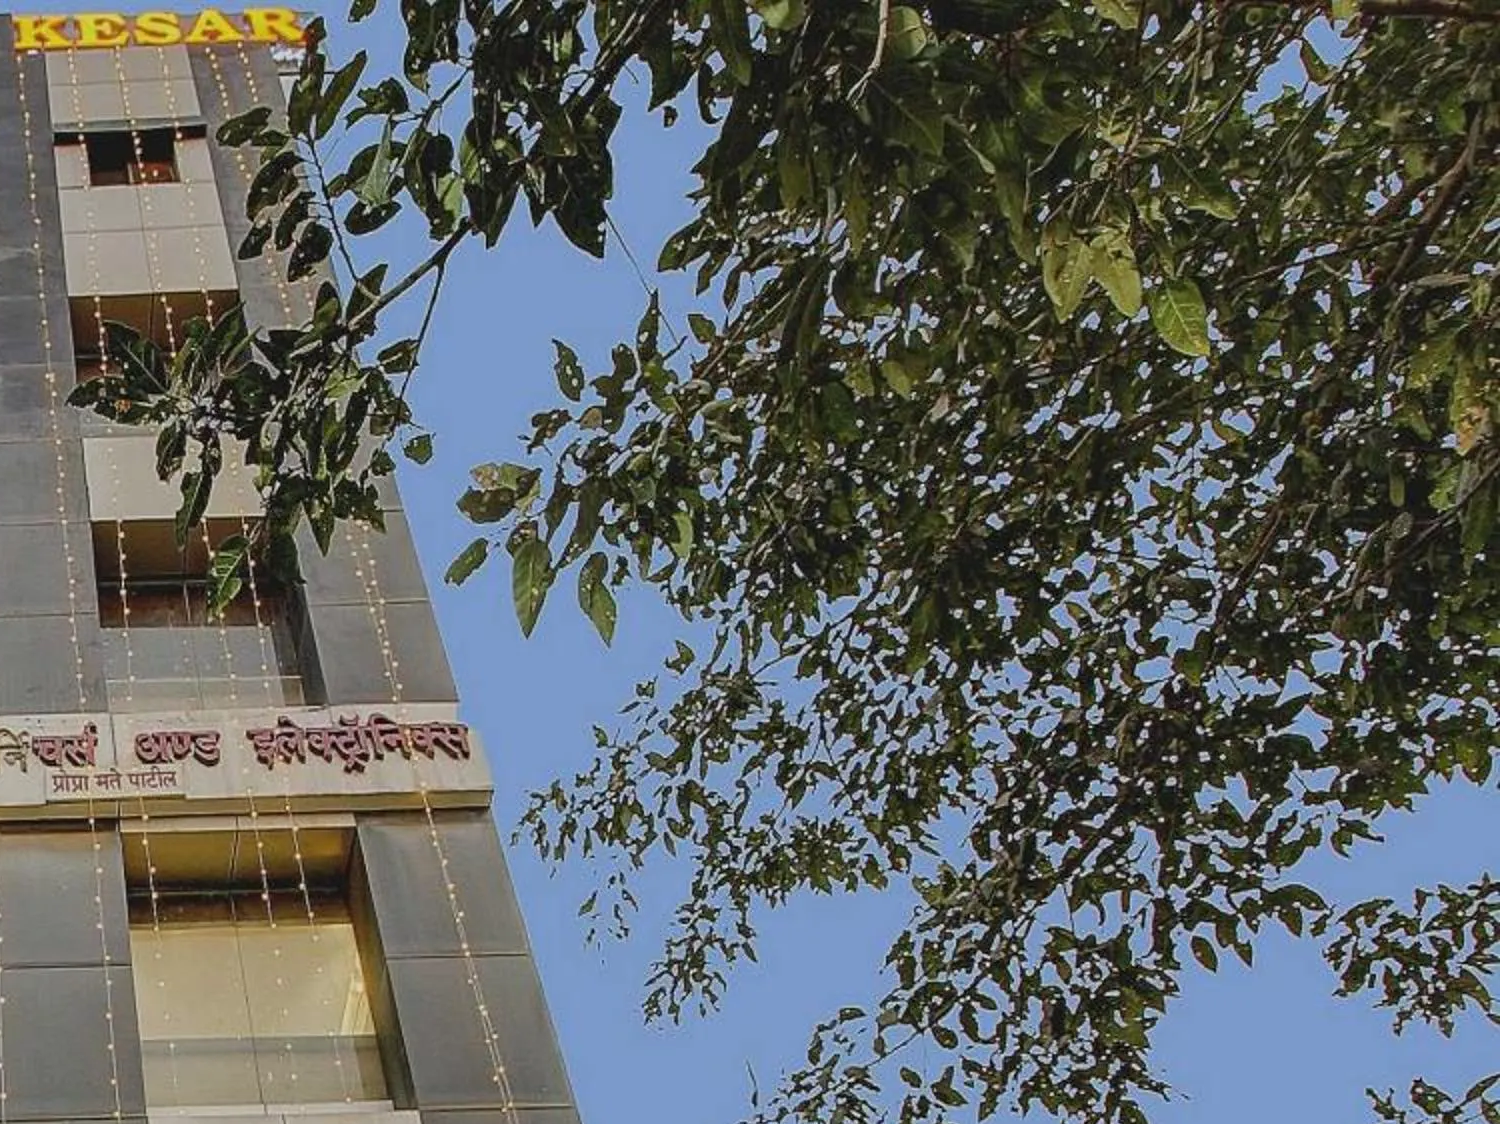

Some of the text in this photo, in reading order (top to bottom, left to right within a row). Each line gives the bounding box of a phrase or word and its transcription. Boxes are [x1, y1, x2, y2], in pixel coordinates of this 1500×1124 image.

[12, 8, 306, 50] KESAR
[134, 729, 221, 767] अण्ड
[128, 765, 177, 789] पाटील
